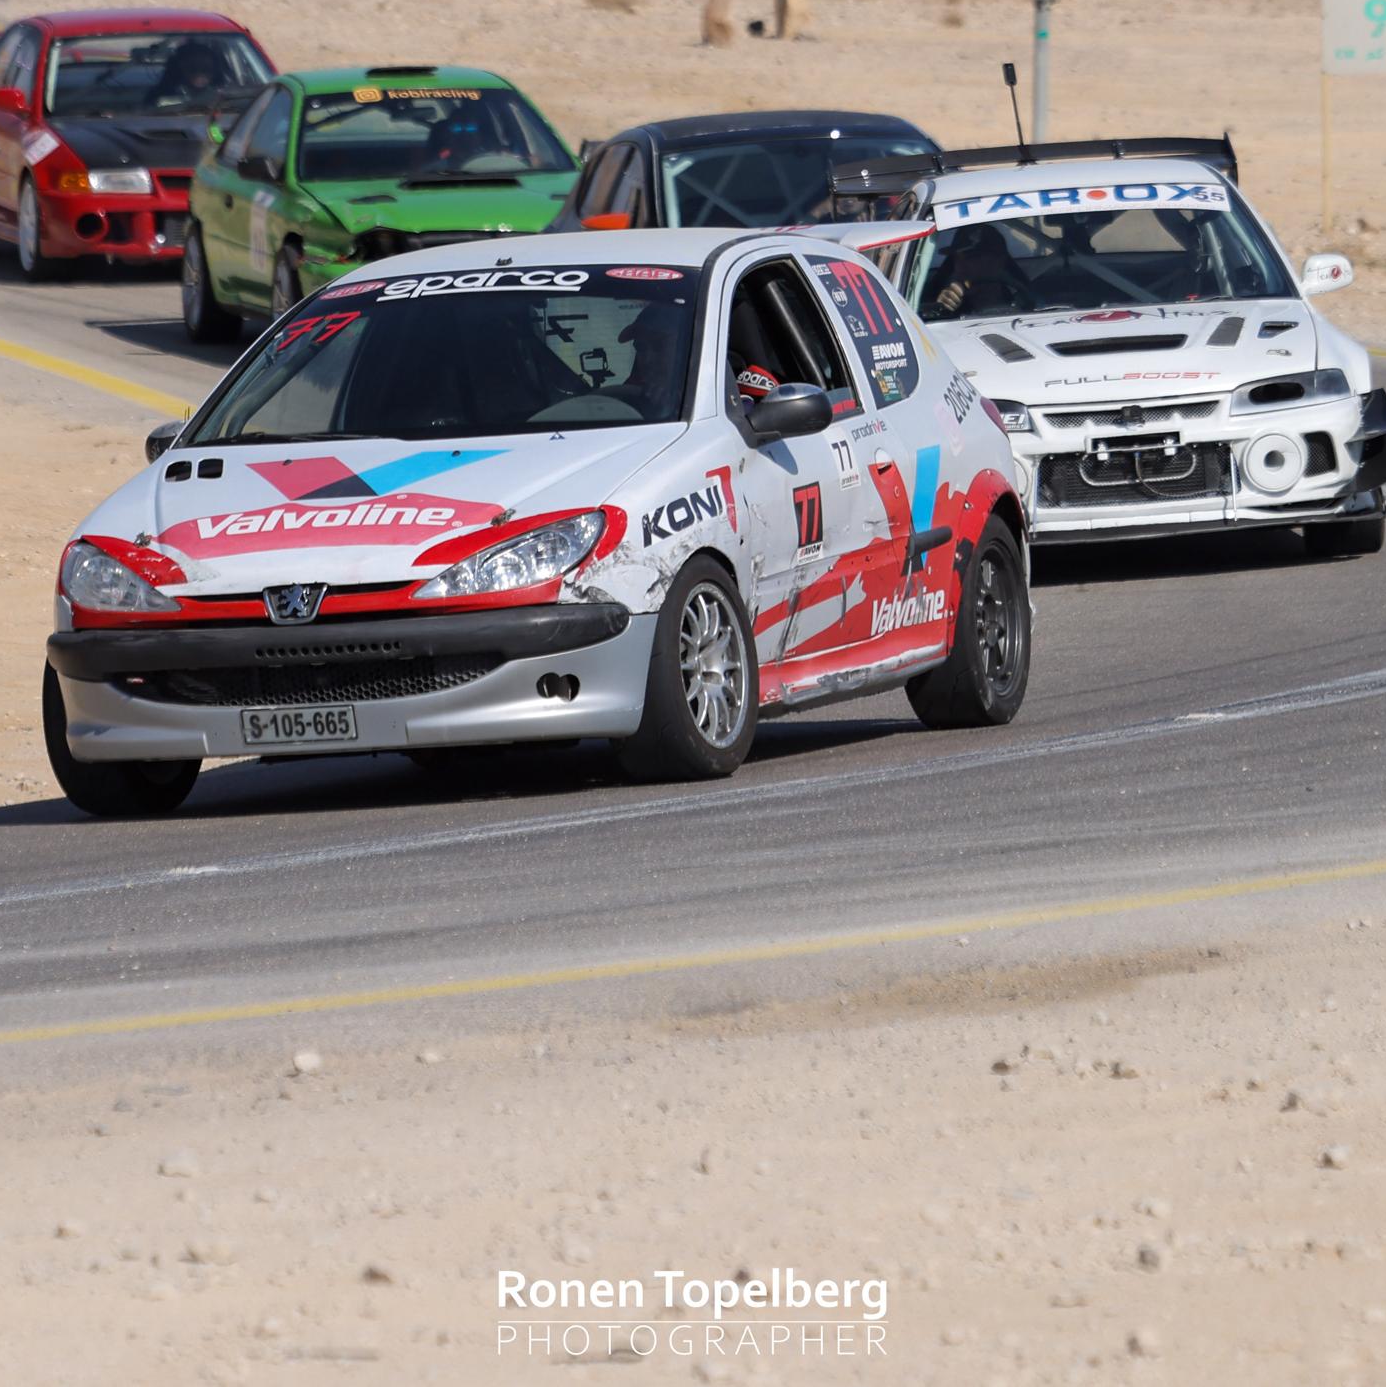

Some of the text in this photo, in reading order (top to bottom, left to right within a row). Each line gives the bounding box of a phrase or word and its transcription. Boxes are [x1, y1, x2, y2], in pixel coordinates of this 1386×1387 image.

[388, 88, 482, 101] kobiracing
[376, 270, 590, 302] sparco
[827, 262, 894, 335] 77
[276, 311, 361, 352] 77
[879, 342, 905, 359] AVON
[851, 419, 887, 443] prodrive
[831, 440, 853, 472] 77
[196, 503, 456, 540] Valvoline
[641, 484, 723, 549] KONI
[794, 485, 819, 546] 77
[870, 585, 946, 638] Valvoline
[249, 711, 351, 739] S-105-665
